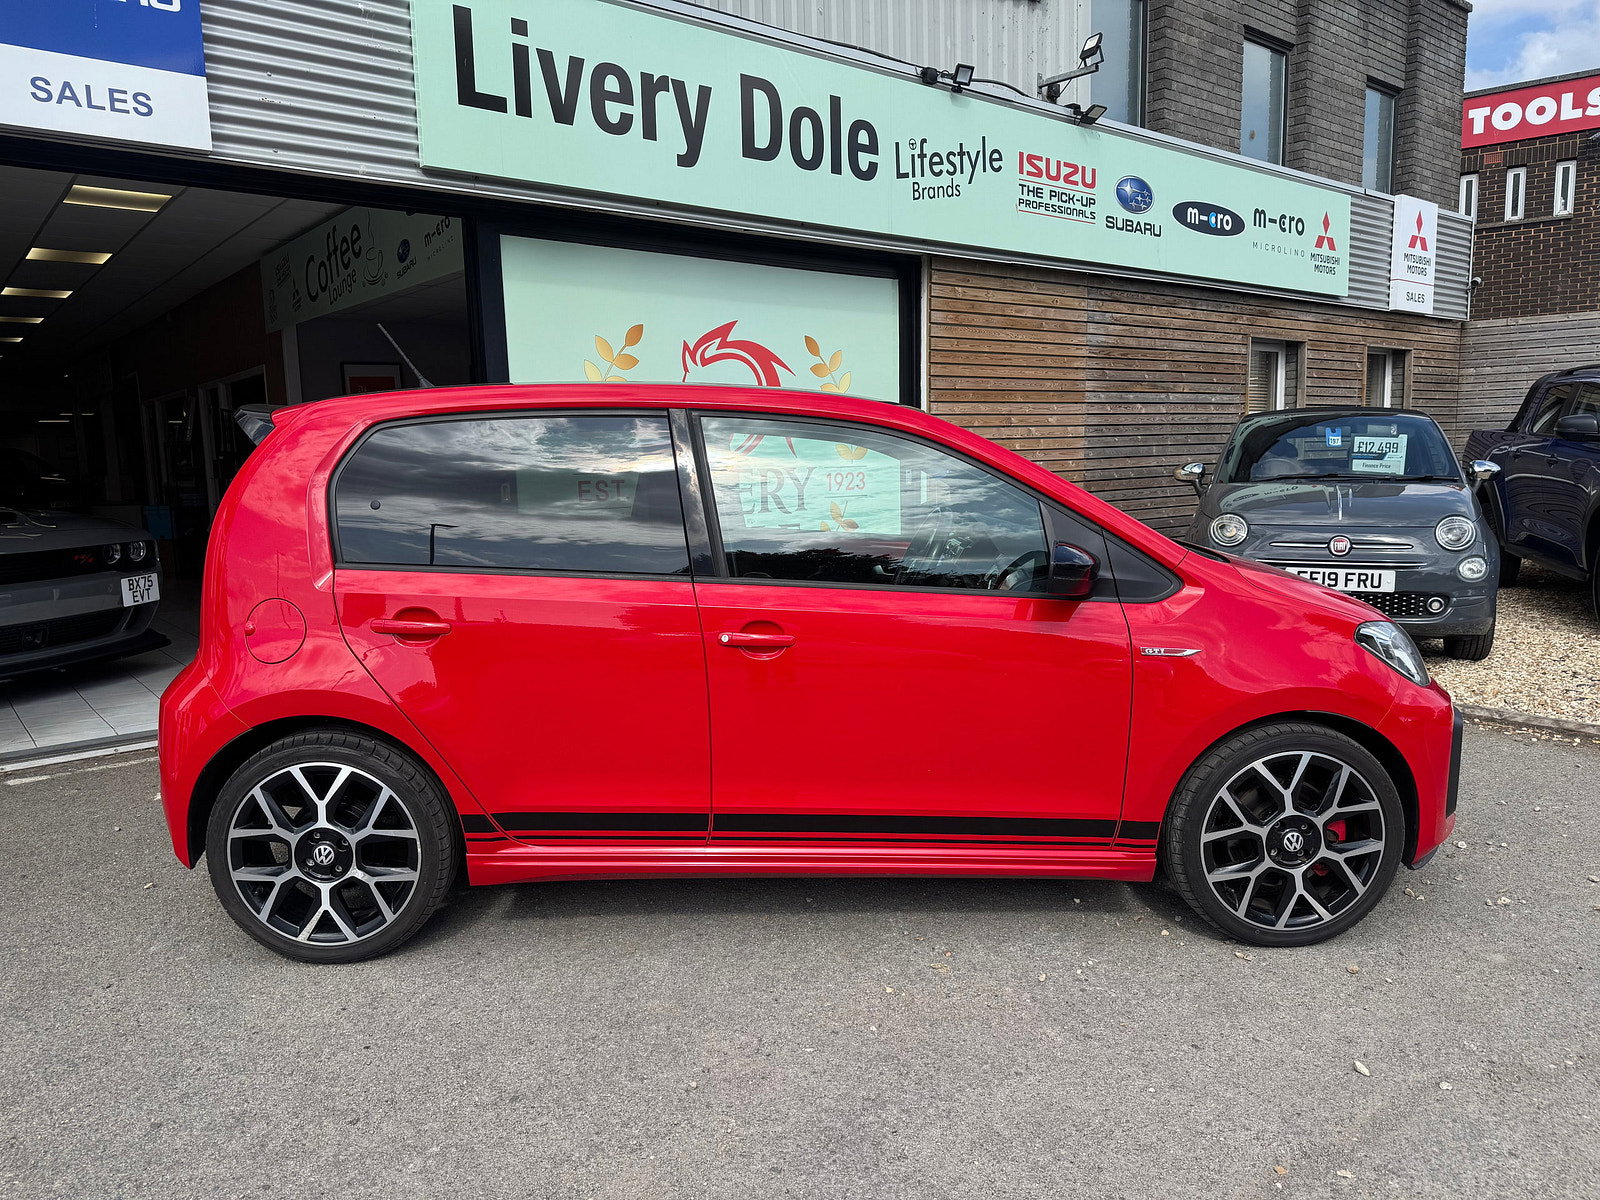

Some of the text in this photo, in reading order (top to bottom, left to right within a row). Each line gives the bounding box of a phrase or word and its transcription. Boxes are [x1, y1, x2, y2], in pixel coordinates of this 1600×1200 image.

[30, 76, 154, 117] SALES
[452, 4, 879, 182] Livery Dole
[1468, 86, 1600, 135] TOOLS
[895, 136, 1004, 184] Lifestyle
[1018, 151, 1097, 190] ISUZU
[912, 178, 962, 201] Brands
[1018, 184, 1096, 209] THE PICK-UP
[1018, 198, 1096, 220] PROFESSIONALS
[1105, 215, 1162, 238] SUBARU
[1252, 241, 1305, 258] MICROLINO
[1310, 252, 1341, 266] MITSUBISHI
[1403, 252, 1432, 267] MITSUBISHI
[305, 223, 362, 303] Coffee
[396, 256, 417, 280] SUBARU
[1313, 264, 1337, 276] MOTORS
[1406, 264, 1428, 277] MOTORS
[328, 268, 357, 306] Lounge
[1405, 291, 1425, 304] SALES
[825, 471, 867, 492] 1923
[1334, 541, 1347, 552] FIAT
[128, 576, 153, 591] BX75
[1344, 572, 1382, 588] FRU
[132, 588, 151, 603] EVT
